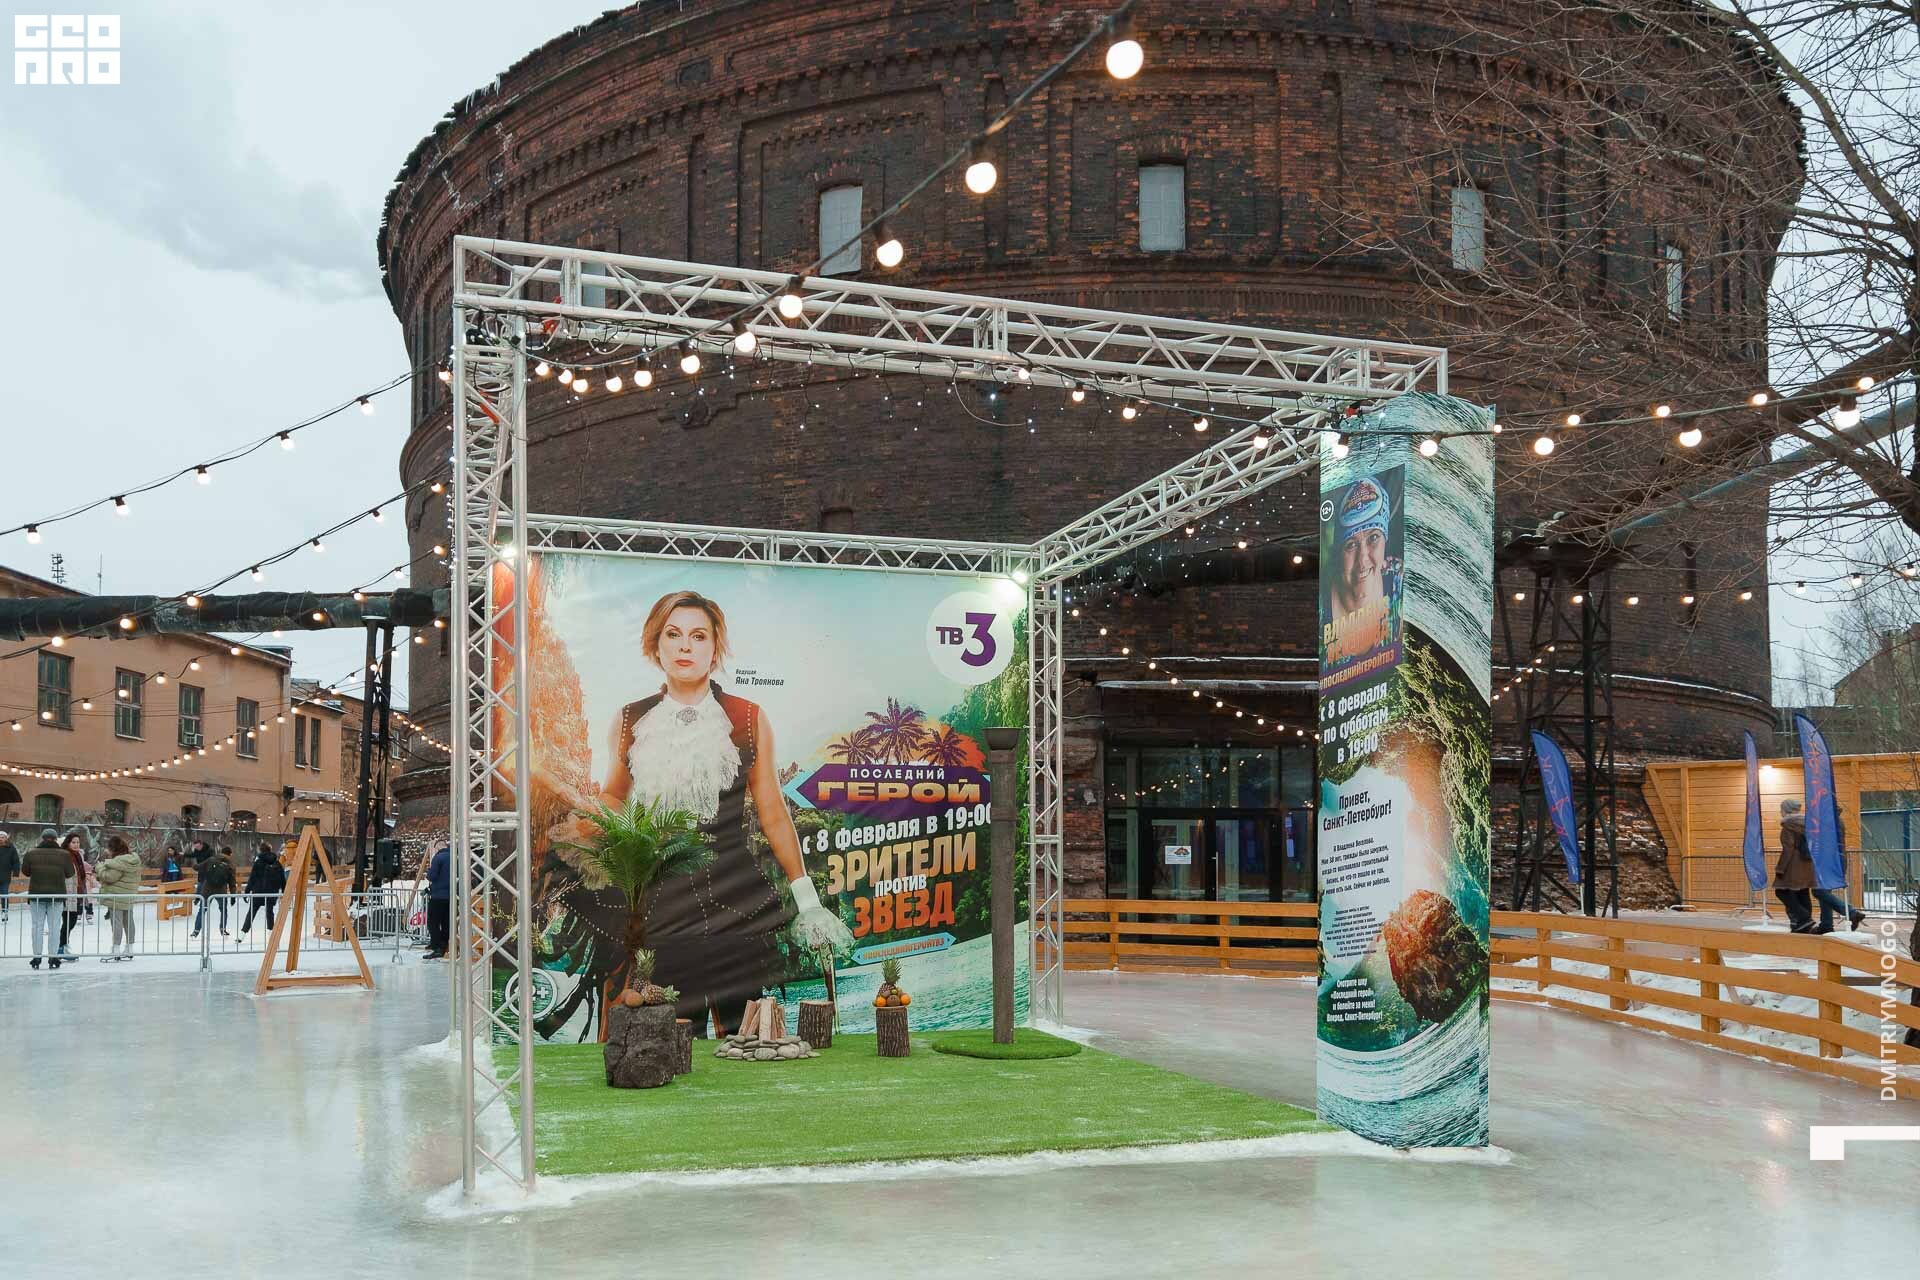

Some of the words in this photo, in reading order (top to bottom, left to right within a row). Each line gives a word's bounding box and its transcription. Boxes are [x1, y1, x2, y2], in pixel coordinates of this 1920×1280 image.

[751, 677, 784, 685] Троянова
[1328, 700, 1335, 718] 8
[1338, 682, 1387, 716] февраля
[1324, 726, 1336, 744] по
[1340, 707, 1388, 739] субботам
[1348, 732, 1378, 759] 19:00
[850, 767, 945, 780] ПОСЛЕДНИЙ
[817, 778, 981, 803] ГЕРОЙ
[1339, 790, 1371, 810] Привет,
[1323, 799, 1392, 831] Санкт-Петербург!
[816, 829, 829, 852] 8
[835, 818, 920, 850] февраля
[827, 831, 977, 895] ЗРИТЕЛИ
[853, 881, 956, 938] ЗВЕЗД
[1337, 979, 1357, 987] Смотрите
[1333, 1003, 1337, 1011] и
[1337, 1001, 1355, 1009] болейте
[1356, 1001, 1361, 1009] за
